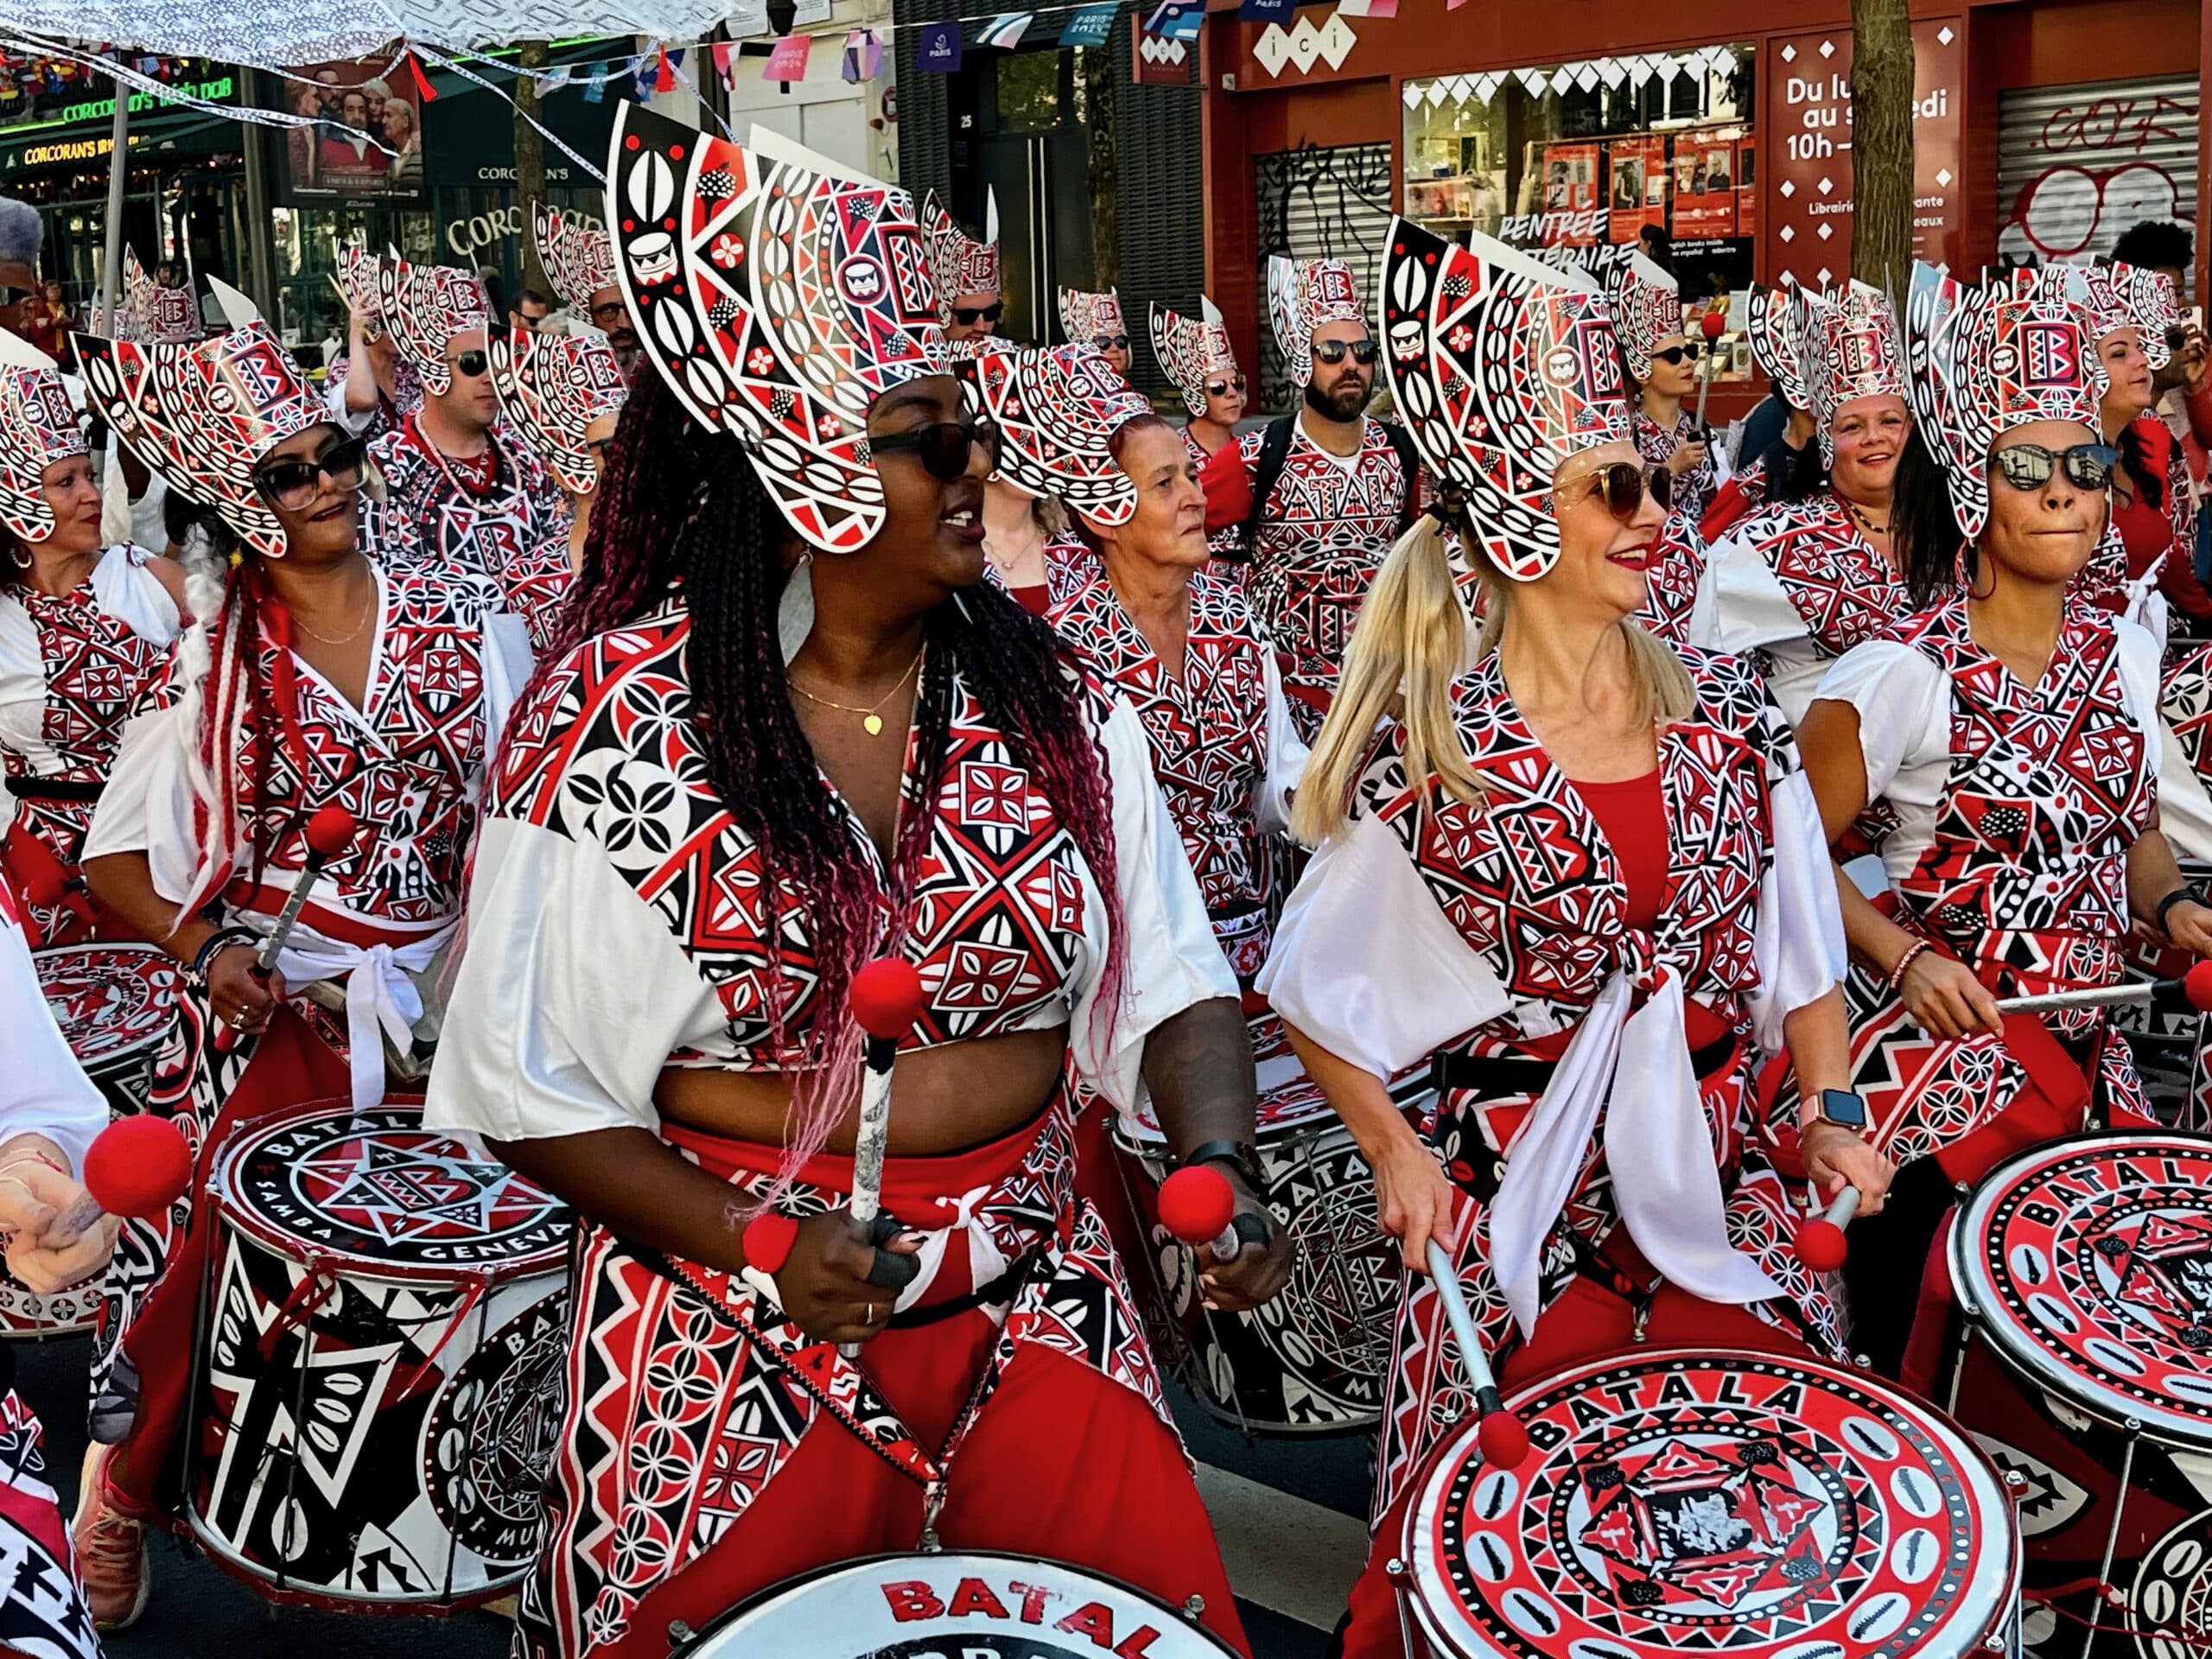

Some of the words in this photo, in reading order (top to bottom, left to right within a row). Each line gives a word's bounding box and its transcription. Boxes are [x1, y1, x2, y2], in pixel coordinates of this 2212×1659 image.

[1071, 23, 1103, 34] 2024
[1075, 15, 1108, 24] PARIS
[929, 49, 951, 58] PARIS
[1272, 28, 1337, 57] ici
[1787, 77, 1822, 105] Du
[961, 115, 972, 128] 25
[1803, 107, 1838, 129] au
[24, 142, 96, 166] CORCORAN'S
[1497, 200, 1611, 241] RENTRÉE
[264, 1116, 423, 1157] BATAL
[257, 1180, 331, 1239] SAMBA
[1526, 1372, 1808, 1453] BATALA
